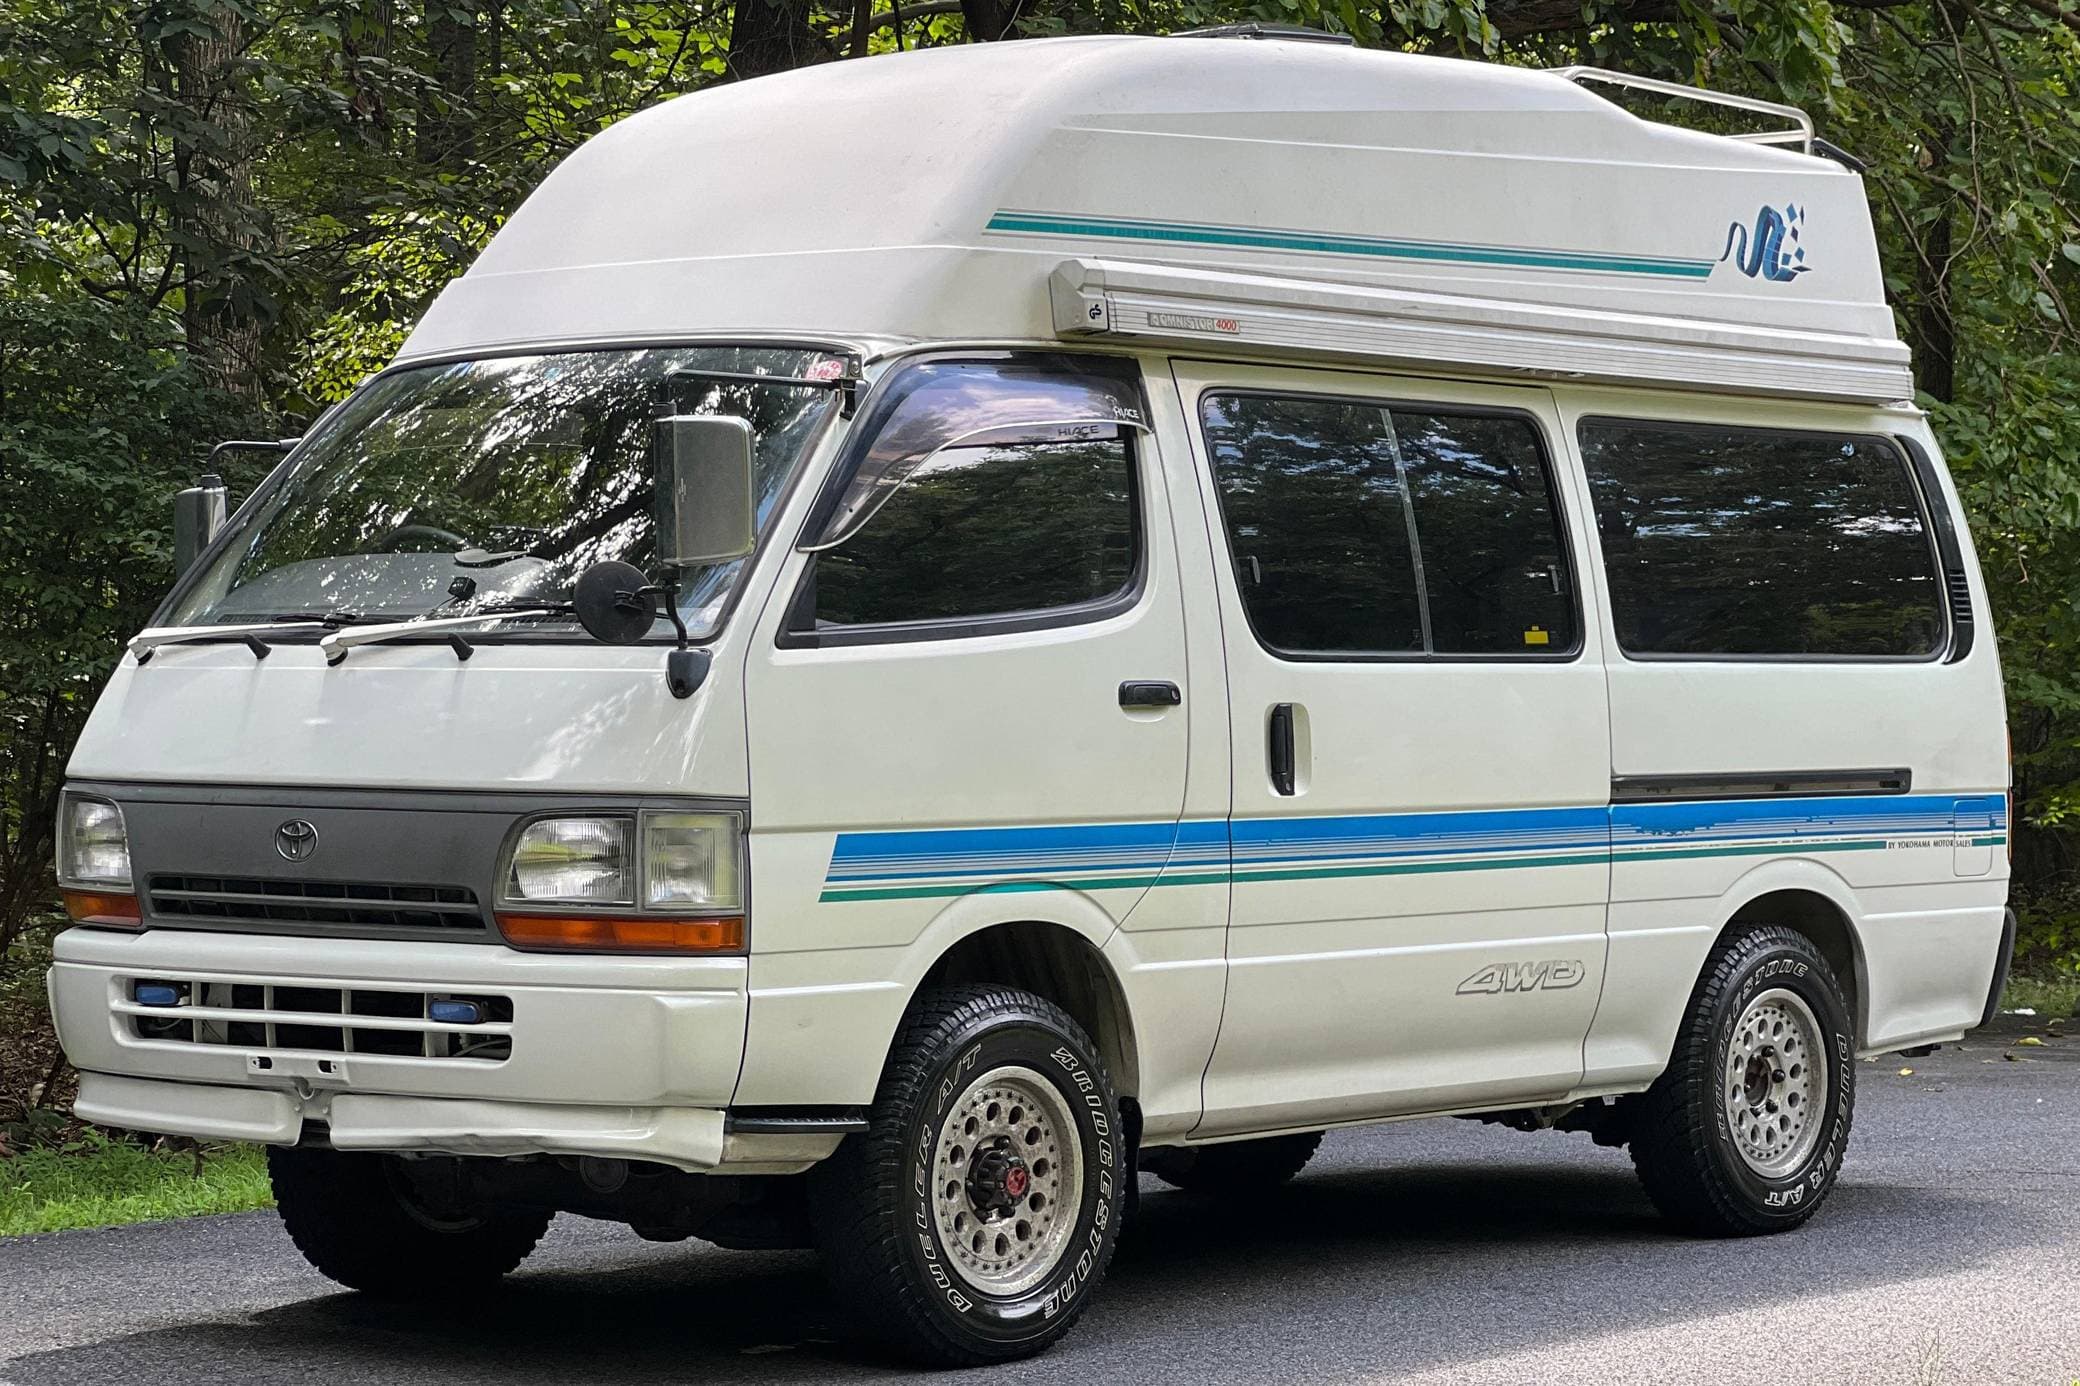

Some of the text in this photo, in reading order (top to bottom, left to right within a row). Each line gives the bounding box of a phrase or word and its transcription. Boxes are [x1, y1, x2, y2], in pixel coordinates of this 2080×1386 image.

[1159, 314, 1237, 332] OMNISTOR 4000
[1057, 425, 1100, 438] HIACE
[1888, 840, 1971, 849] BY YOKOHAMA MOTOR SALES
[1455, 960, 1585, 995] 4WD
[1764, 1032, 1850, 1206] DUELER A/T
[915, 1044, 982, 1312] DUELER A/T
[1042, 1046, 1112, 1319] BRIDGESTONE
